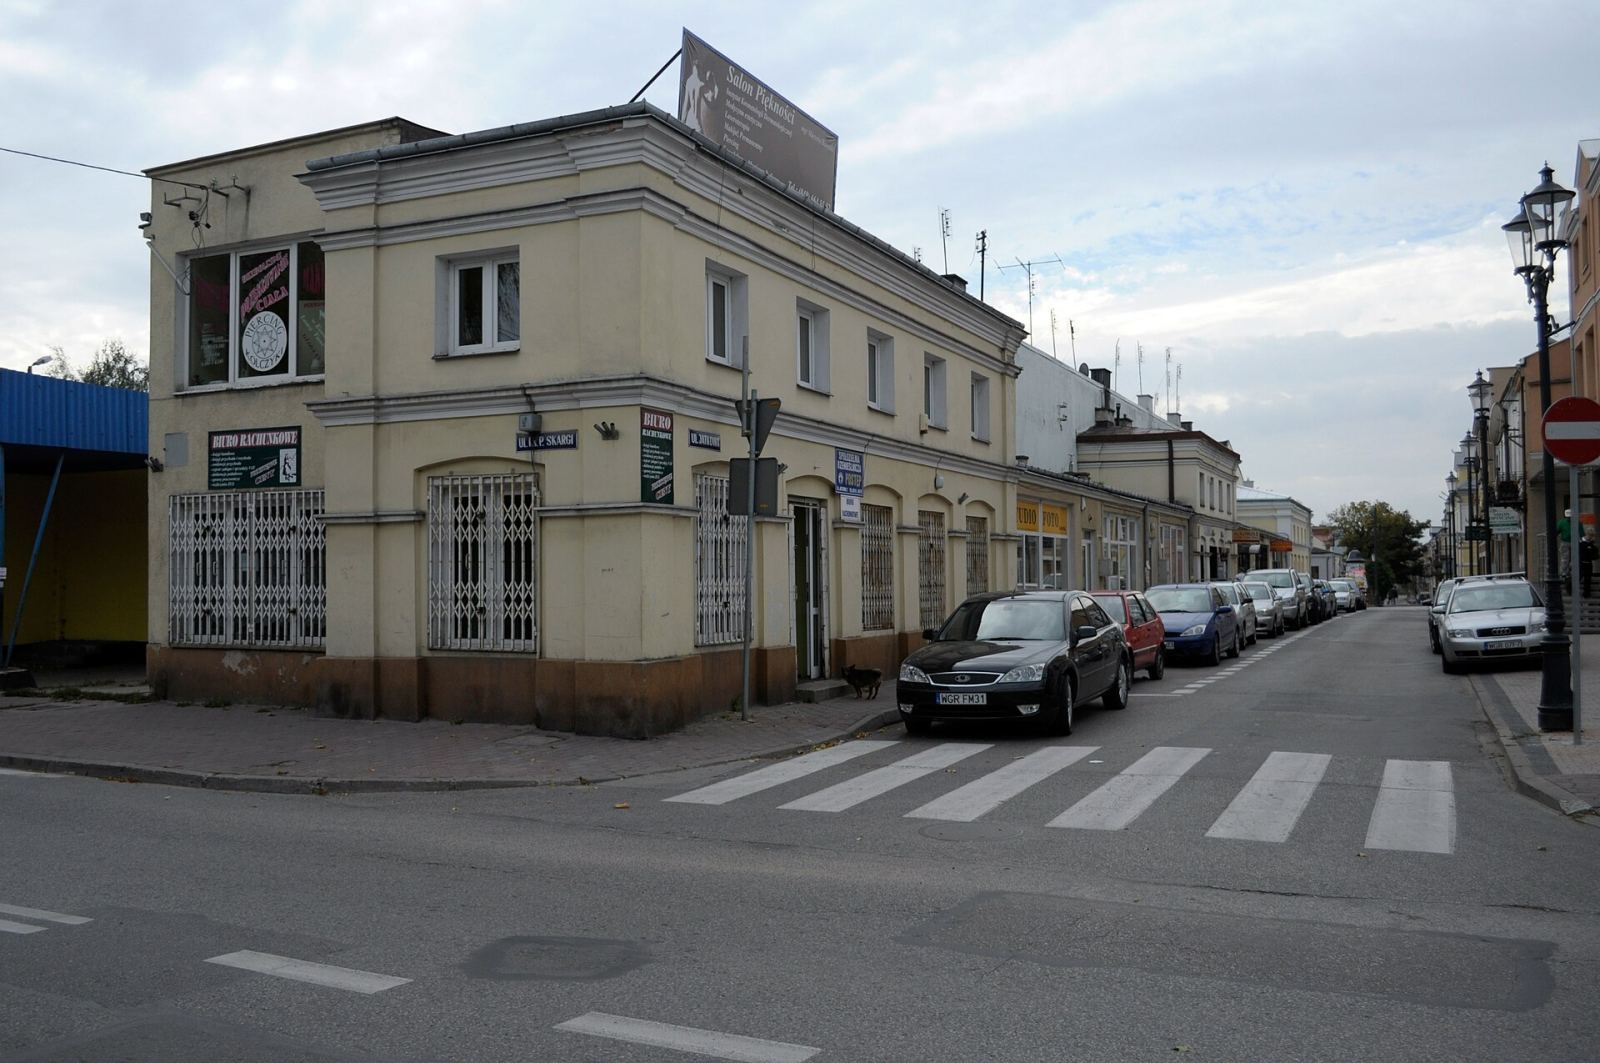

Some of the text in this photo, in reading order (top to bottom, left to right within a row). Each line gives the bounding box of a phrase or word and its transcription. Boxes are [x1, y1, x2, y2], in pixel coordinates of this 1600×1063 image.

[727, 65, 795, 125] Salon Piękności
[256, 286, 289, 312] CIAŁA
[245, 314, 284, 338] PIERCING
[643, 412, 672, 430] BIURO
[212, 431, 298, 448] BIURO RACHUNKOWE
[546, 434, 574, 446] SKARGI
[1016, 507, 1059, 528] UDIO FOTO
[942, 694, 985, 704] WGR FM31
